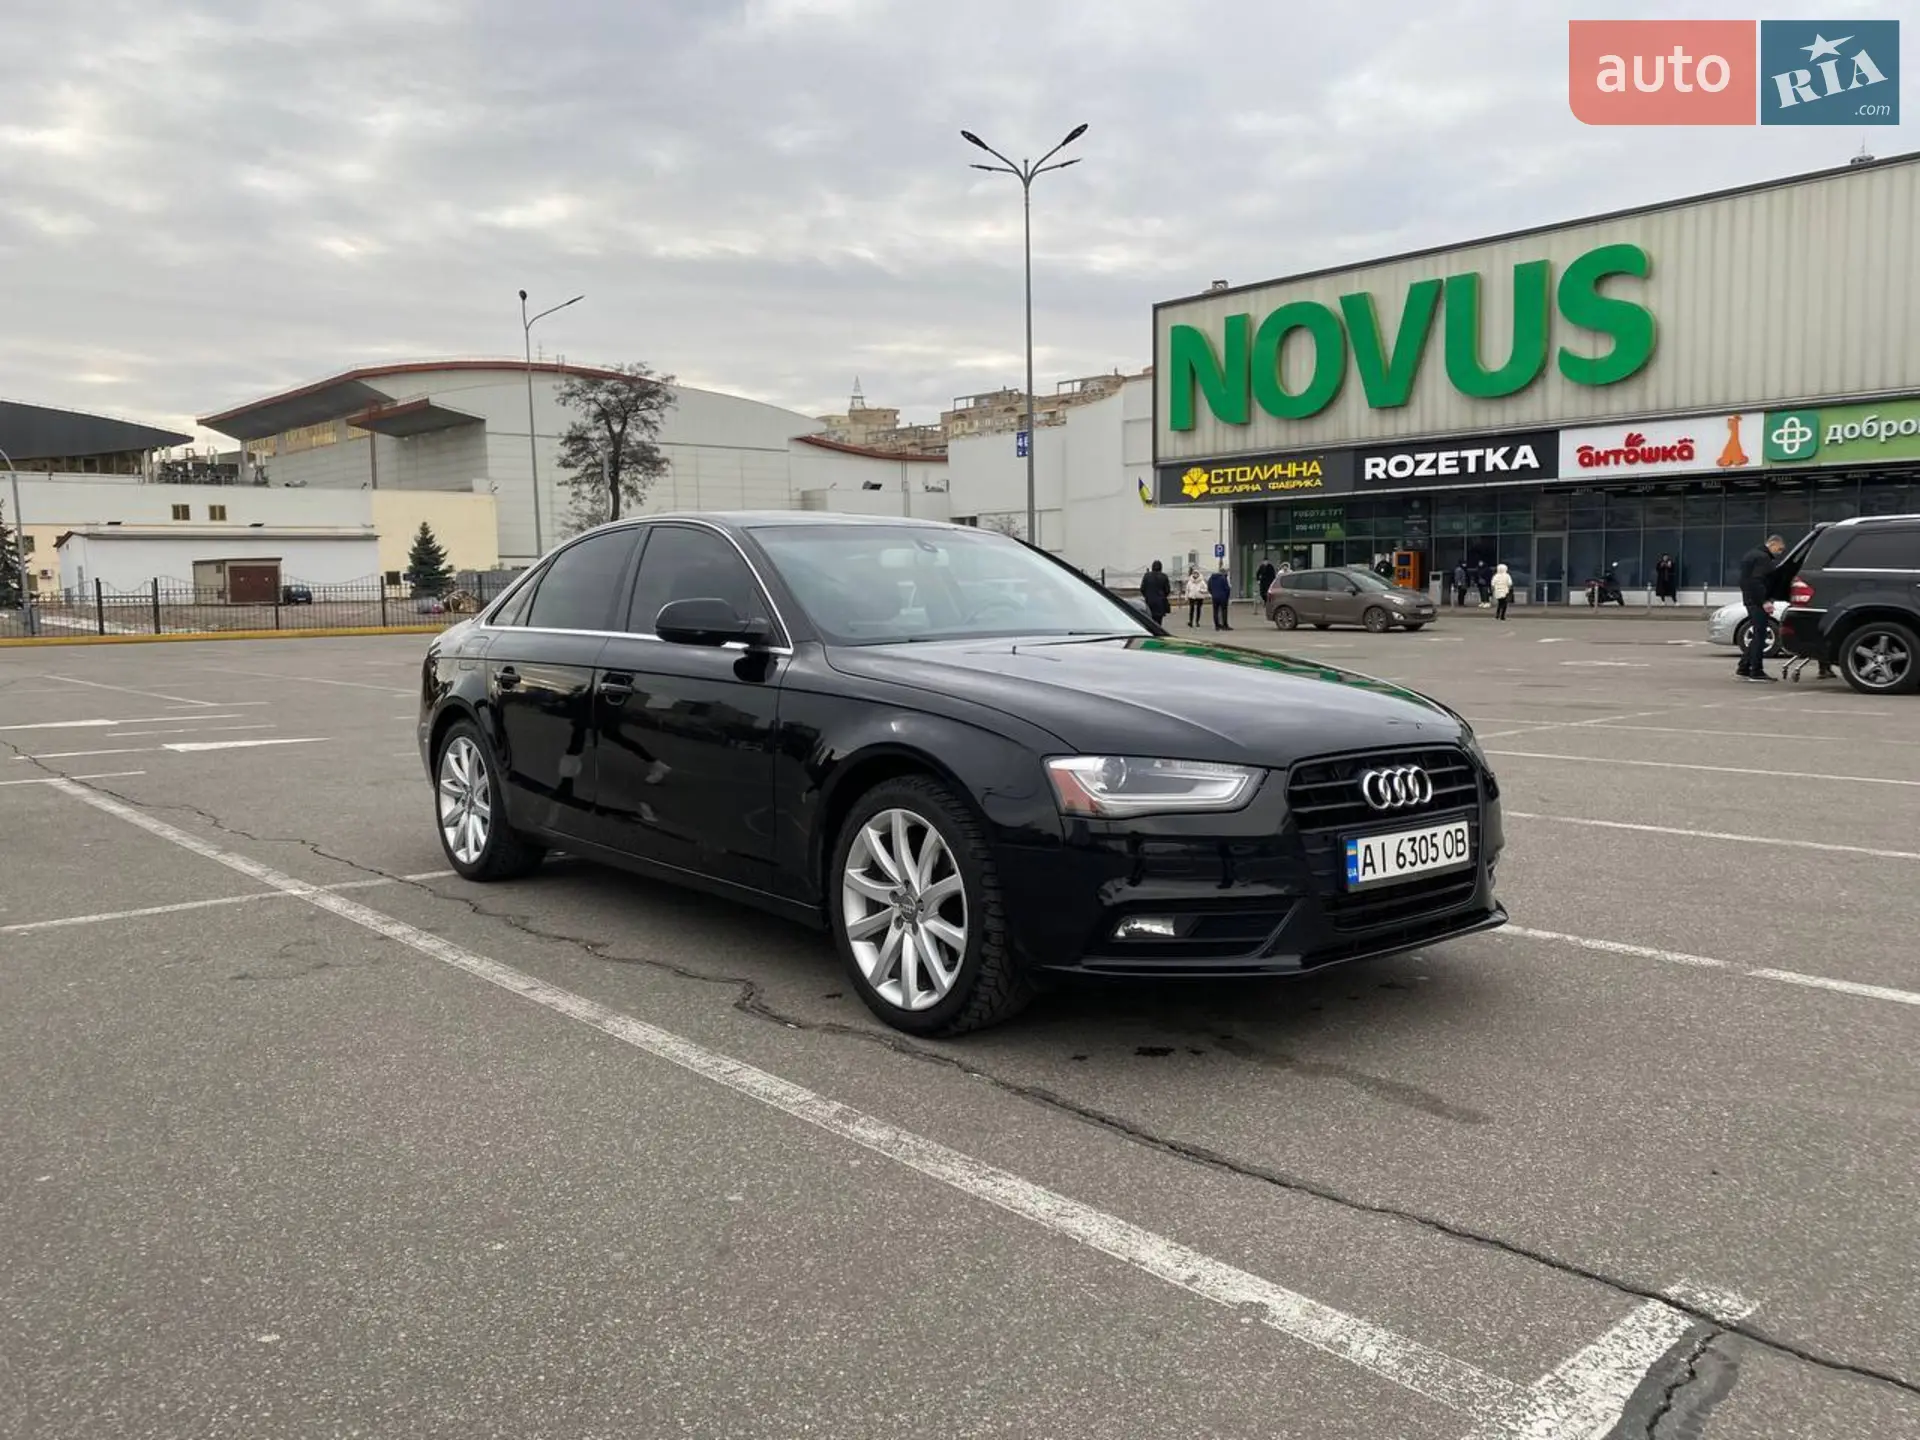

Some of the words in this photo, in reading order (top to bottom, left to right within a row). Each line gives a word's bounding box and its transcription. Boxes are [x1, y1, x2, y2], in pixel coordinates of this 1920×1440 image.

[1169, 243, 1657, 433] NOVUS
[1825, 414, 1920, 445] добро
[1211, 460, 1323, 485] СТОЛИЧНА
[1364, 444, 1540, 480] ROZETKA
[1268, 479, 1323, 490] ФАБРИКА
[1362, 842, 1386, 876] AI
[1396, 832, 1439, 869] 6305
[1443, 828, 1466, 859] OB
